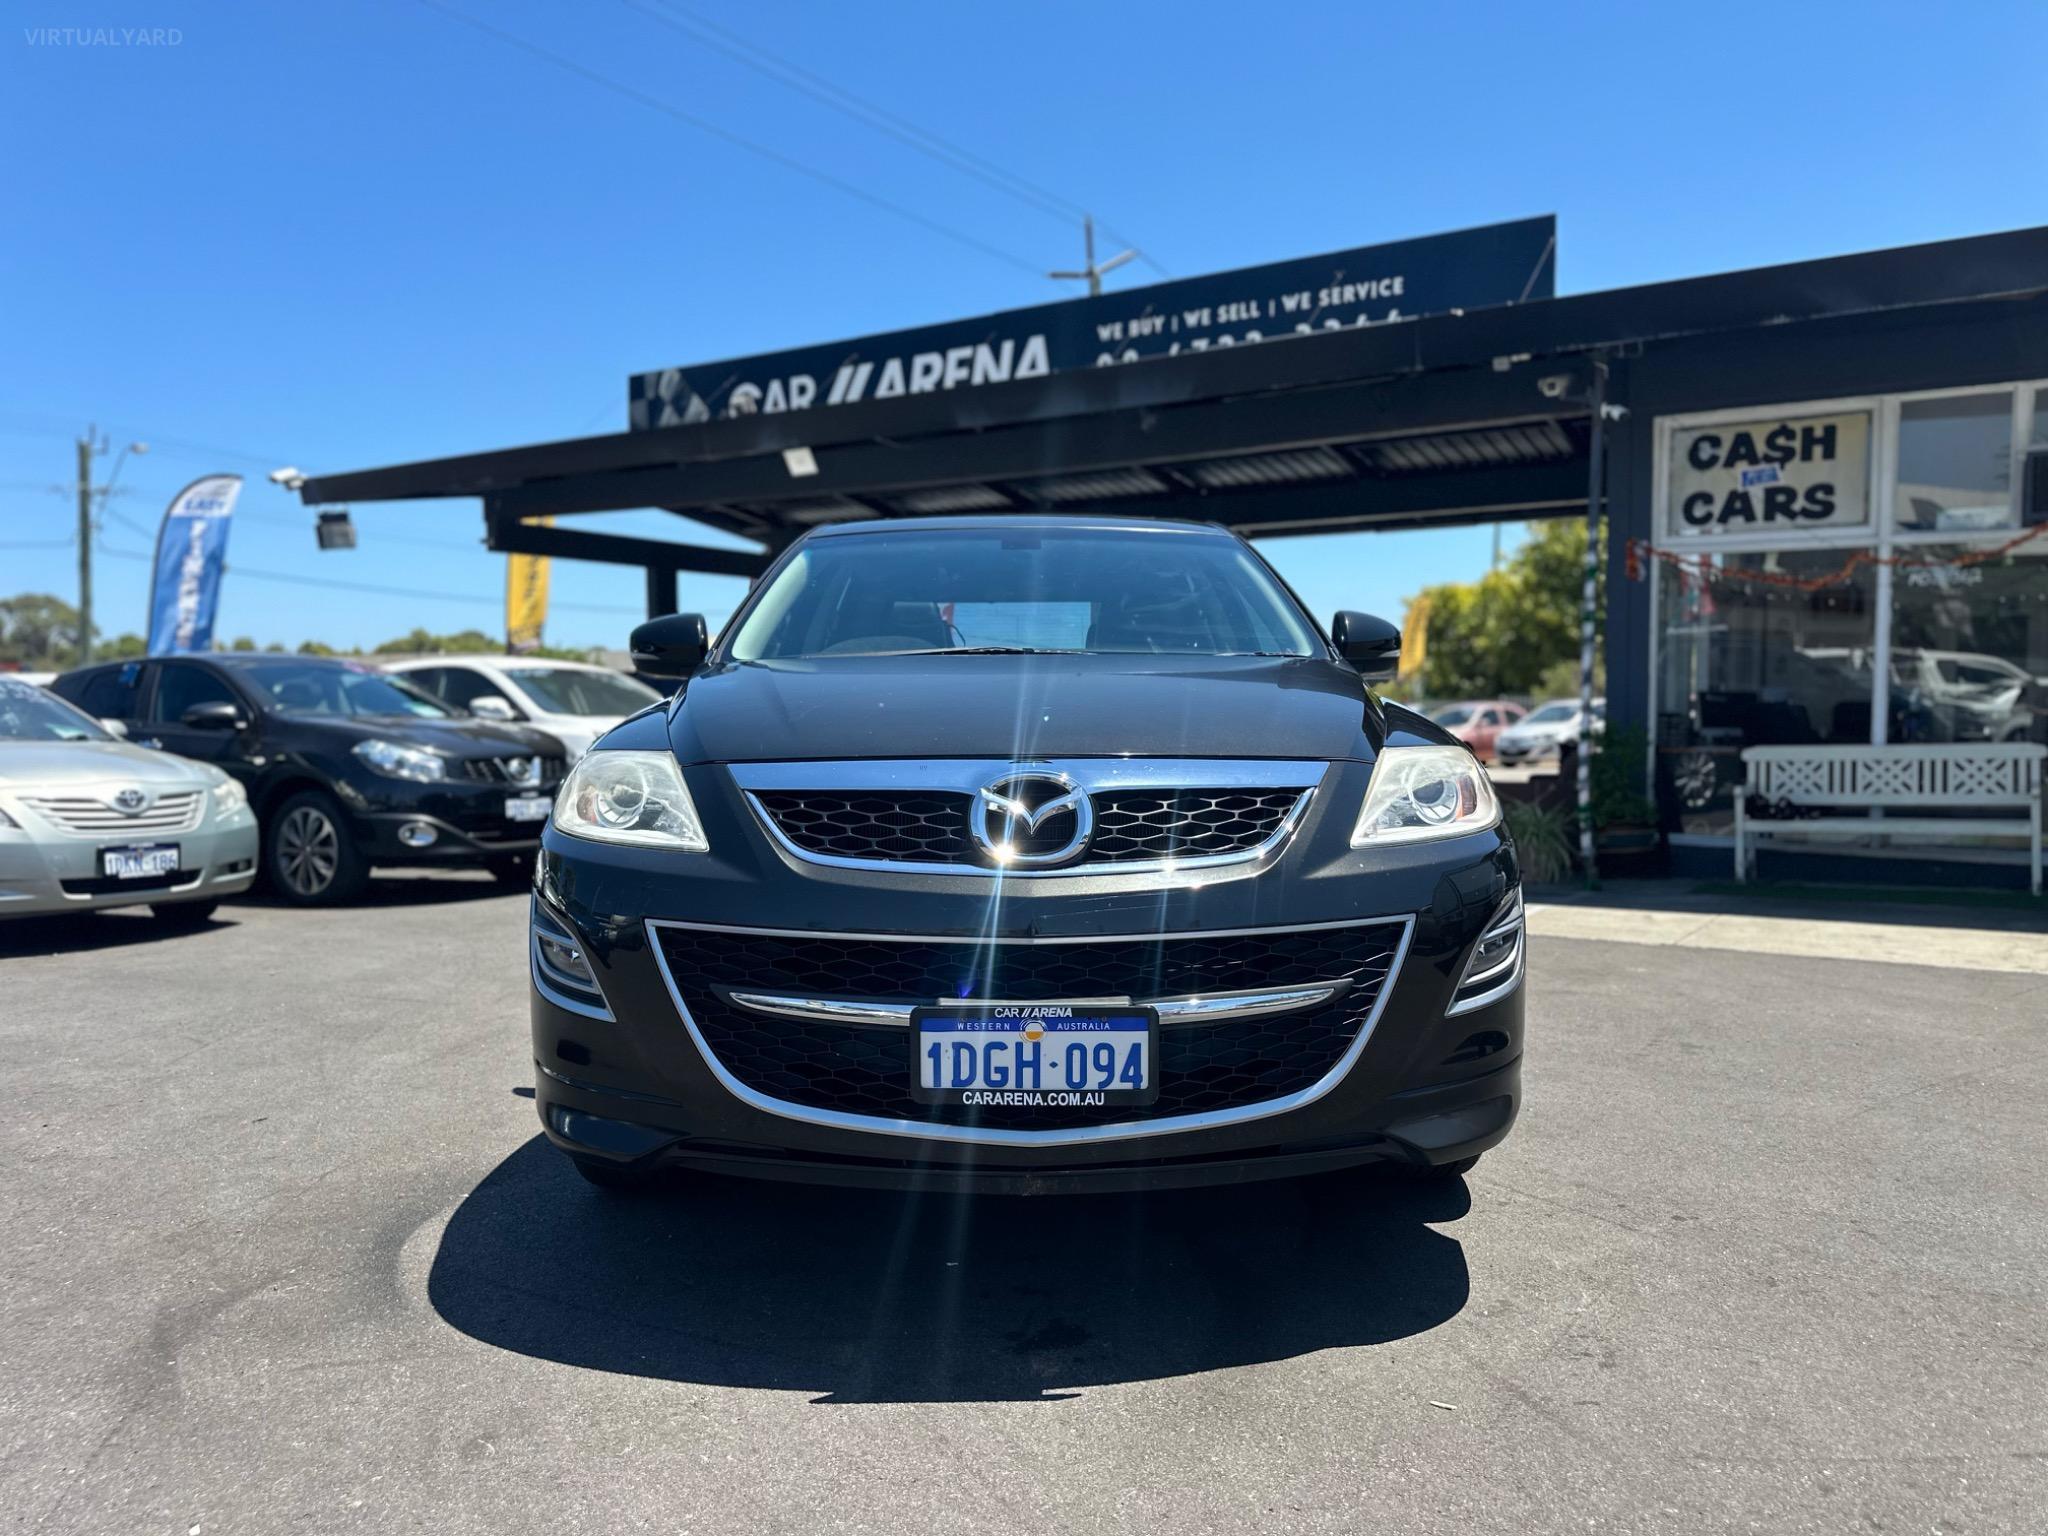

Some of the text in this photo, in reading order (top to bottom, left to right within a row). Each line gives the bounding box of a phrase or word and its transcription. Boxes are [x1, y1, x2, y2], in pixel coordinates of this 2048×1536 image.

[1096, 321, 1123, 342] WE
[1128, 315, 1166, 339] BUY
[1183, 307, 1212, 329] WE
[1217, 300, 1262, 323] SELL
[1281, 292, 1312, 313] WE
[1318, 276, 1405, 308] SERVICE
[1682, 483, 1837, 526] CARS
[994, 1007, 1020, 1018] CAR
[1031, 1007, 1073, 1018] ARENA
[957, 1022, 1111, 1031] WESTERN AUSTRALIA
[962, 1091, 1105, 1107] CARARENA.COM.AU
